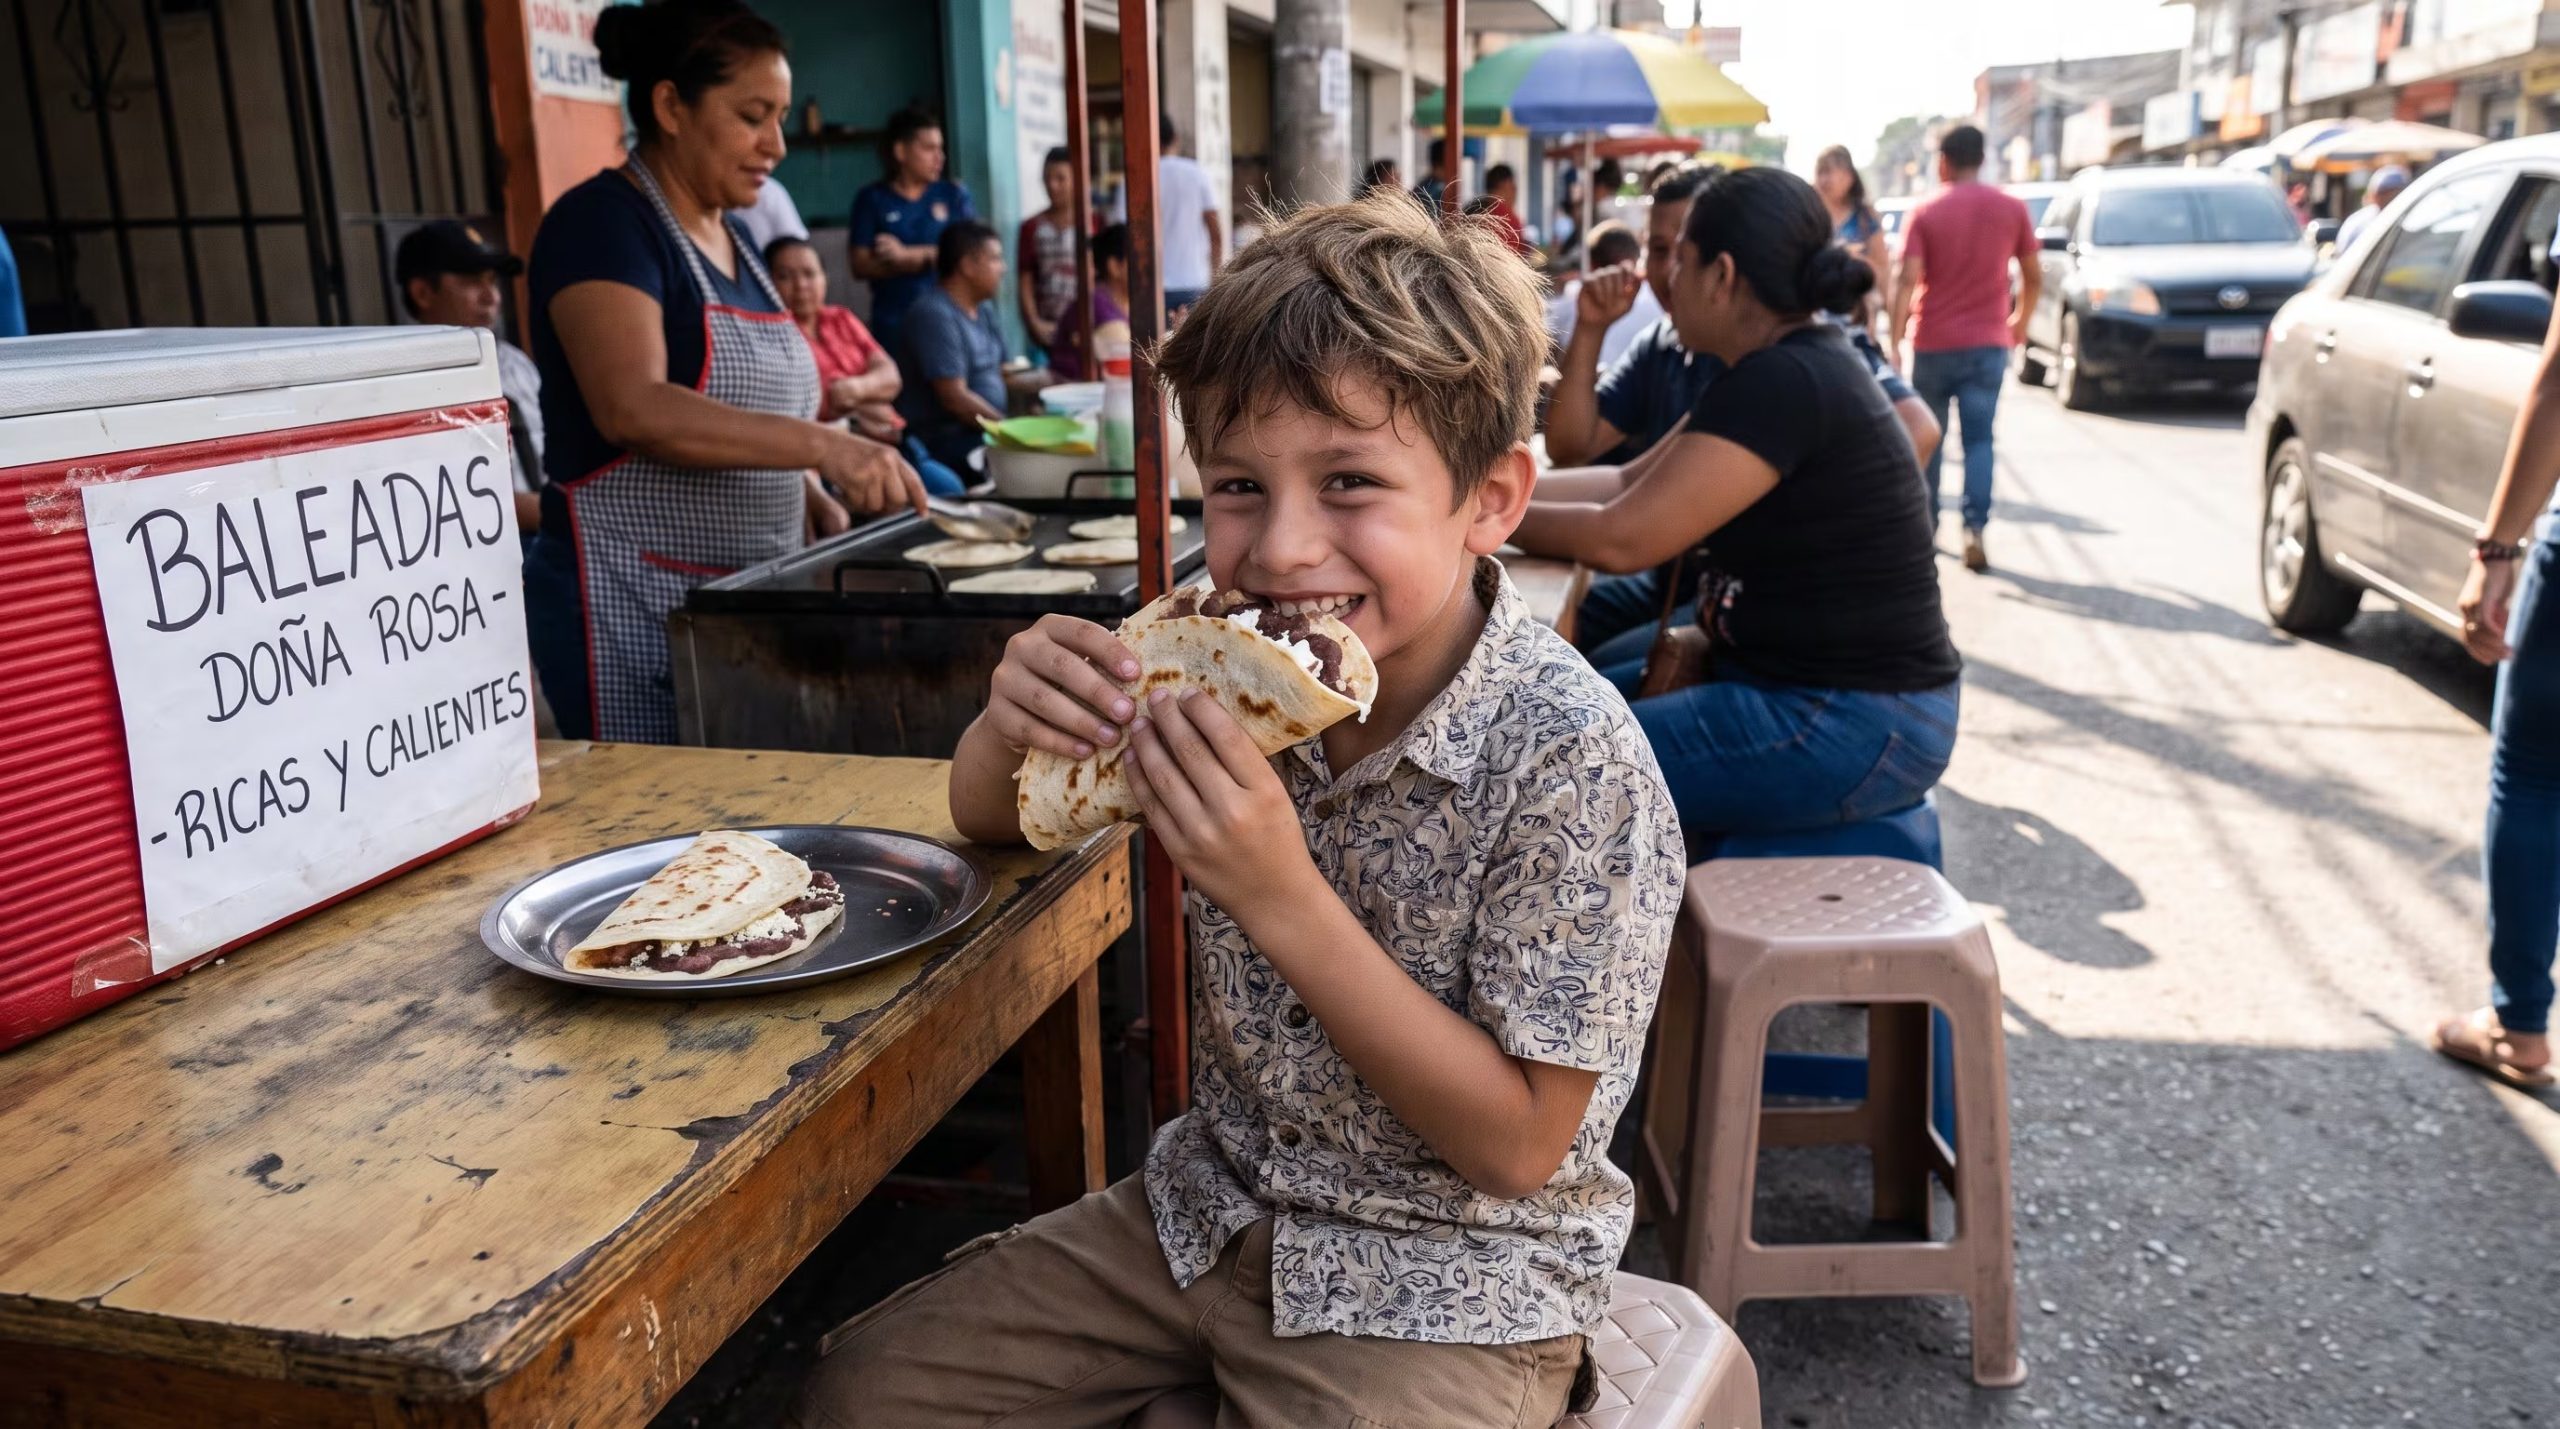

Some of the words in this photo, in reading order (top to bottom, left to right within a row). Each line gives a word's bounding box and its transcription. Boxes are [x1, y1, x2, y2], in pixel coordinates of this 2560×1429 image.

[125, 455, 503, 633] BALEADAS
[199, 613, 353, 723] DOÑA
[323, 739, 348, 813] Y
[366, 670, 527, 778] CALIENTES
